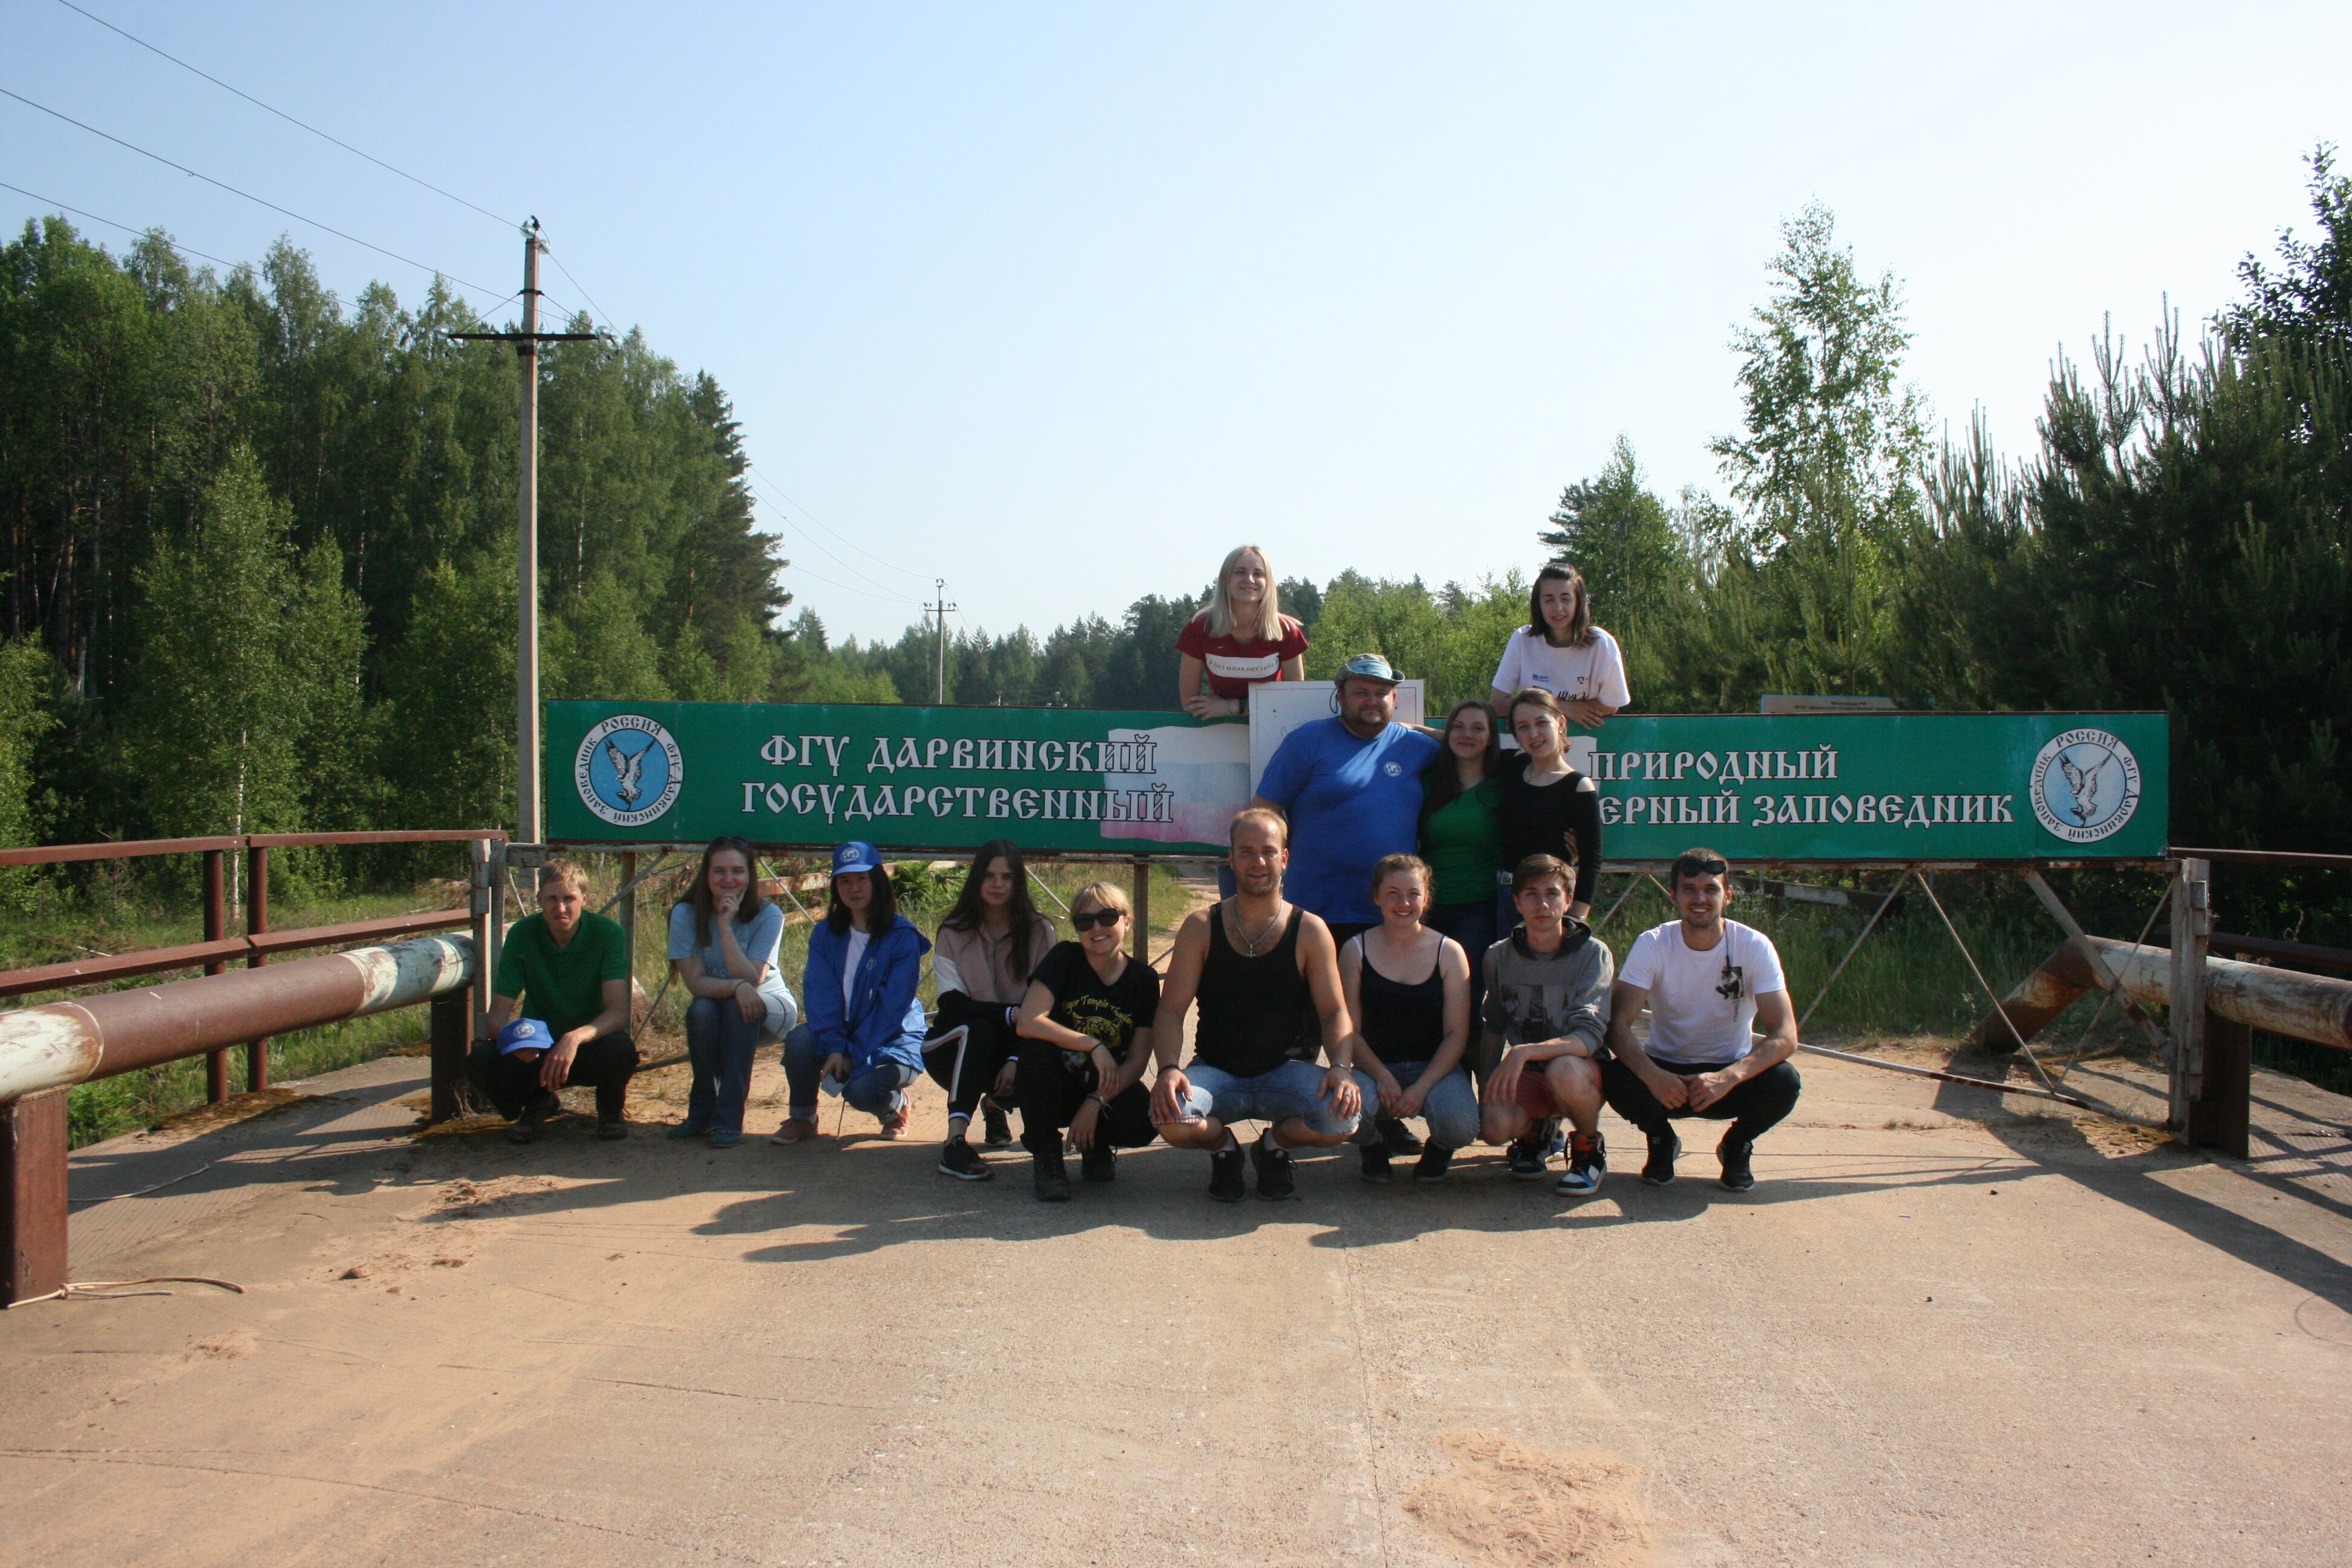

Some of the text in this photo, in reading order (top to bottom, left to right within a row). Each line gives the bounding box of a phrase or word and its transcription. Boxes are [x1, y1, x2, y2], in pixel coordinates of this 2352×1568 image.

[601, 716, 663, 736] РОССИЯ
[2056, 730, 2119, 750] РОССИЯ
[760, 733, 1157, 777] ФГУ ДАРВИНСКИЙ
[1587, 743, 1840, 786] ПРИРОДНЫЙ
[741, 782, 1174, 825] ГОСУДАРСТВЕННЫЙ
[1751, 794, 2014, 830] ЗАПОВЕДНИК
[1081, 995, 1109, 1011] Temple
[1110, 1004, 1133, 1028] Thailan
